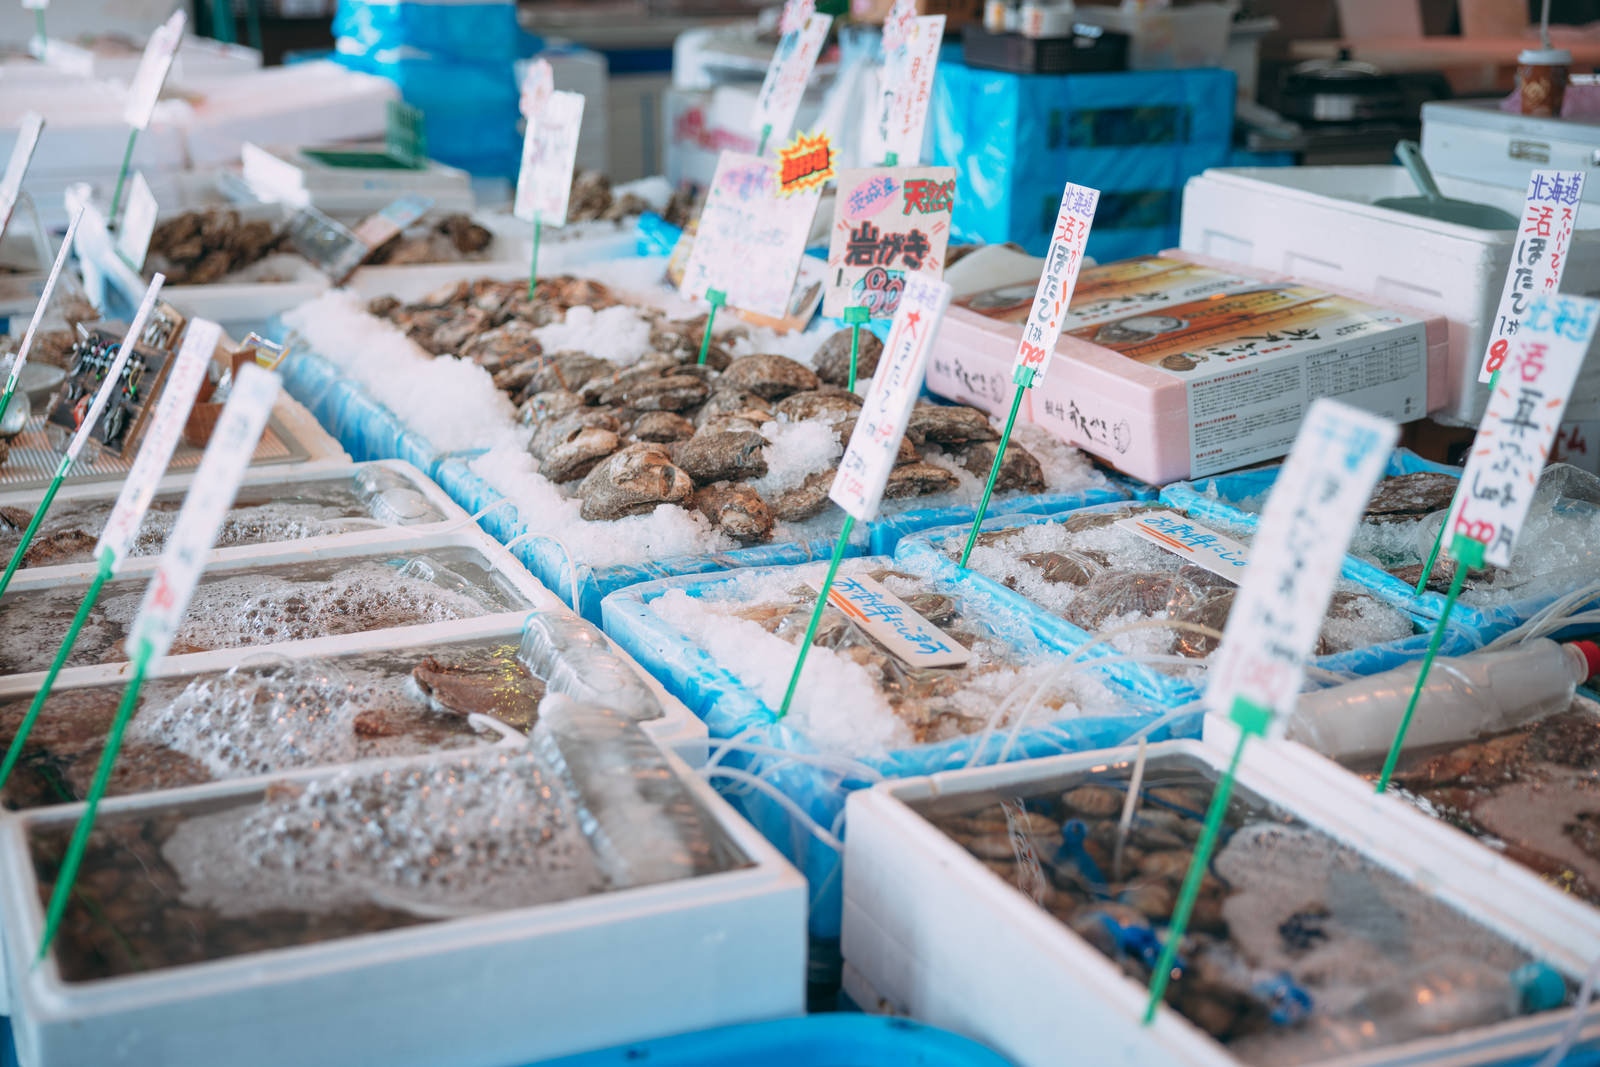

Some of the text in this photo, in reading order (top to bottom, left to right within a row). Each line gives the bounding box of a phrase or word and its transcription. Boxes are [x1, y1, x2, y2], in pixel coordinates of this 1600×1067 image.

[1061, 185, 1095, 218] 北海道
[1527, 172, 1582, 206] 北海道
[844, 220, 932, 271] 岩がき
